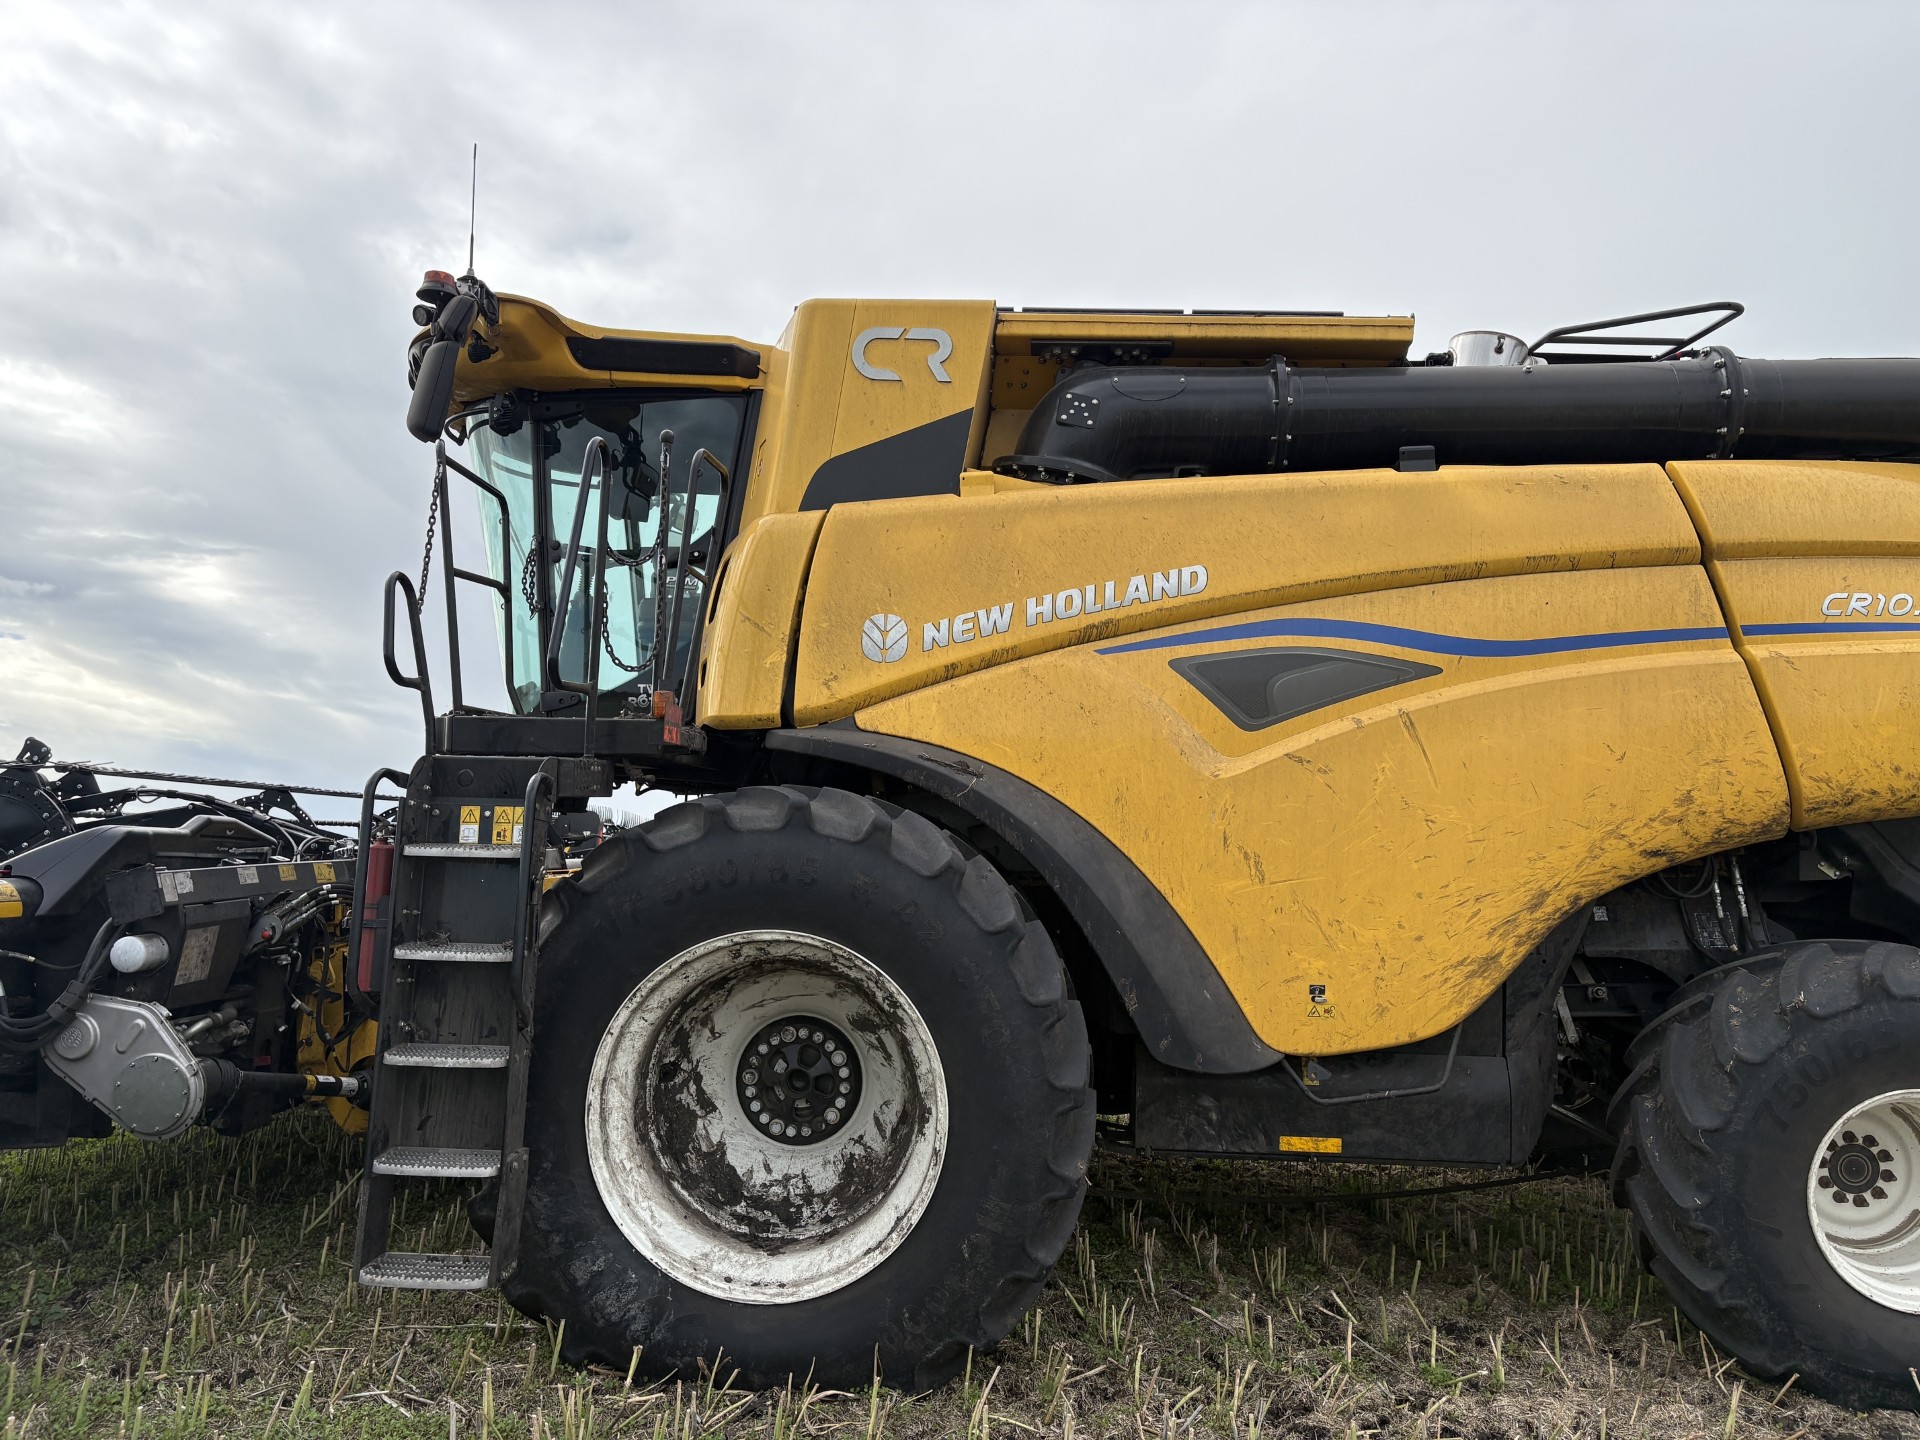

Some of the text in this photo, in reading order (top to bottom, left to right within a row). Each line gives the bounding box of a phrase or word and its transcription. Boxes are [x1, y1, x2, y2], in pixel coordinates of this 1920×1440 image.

[851, 326, 953, 383] CR
[922, 564, 1208, 652] NEW HOLLAND
